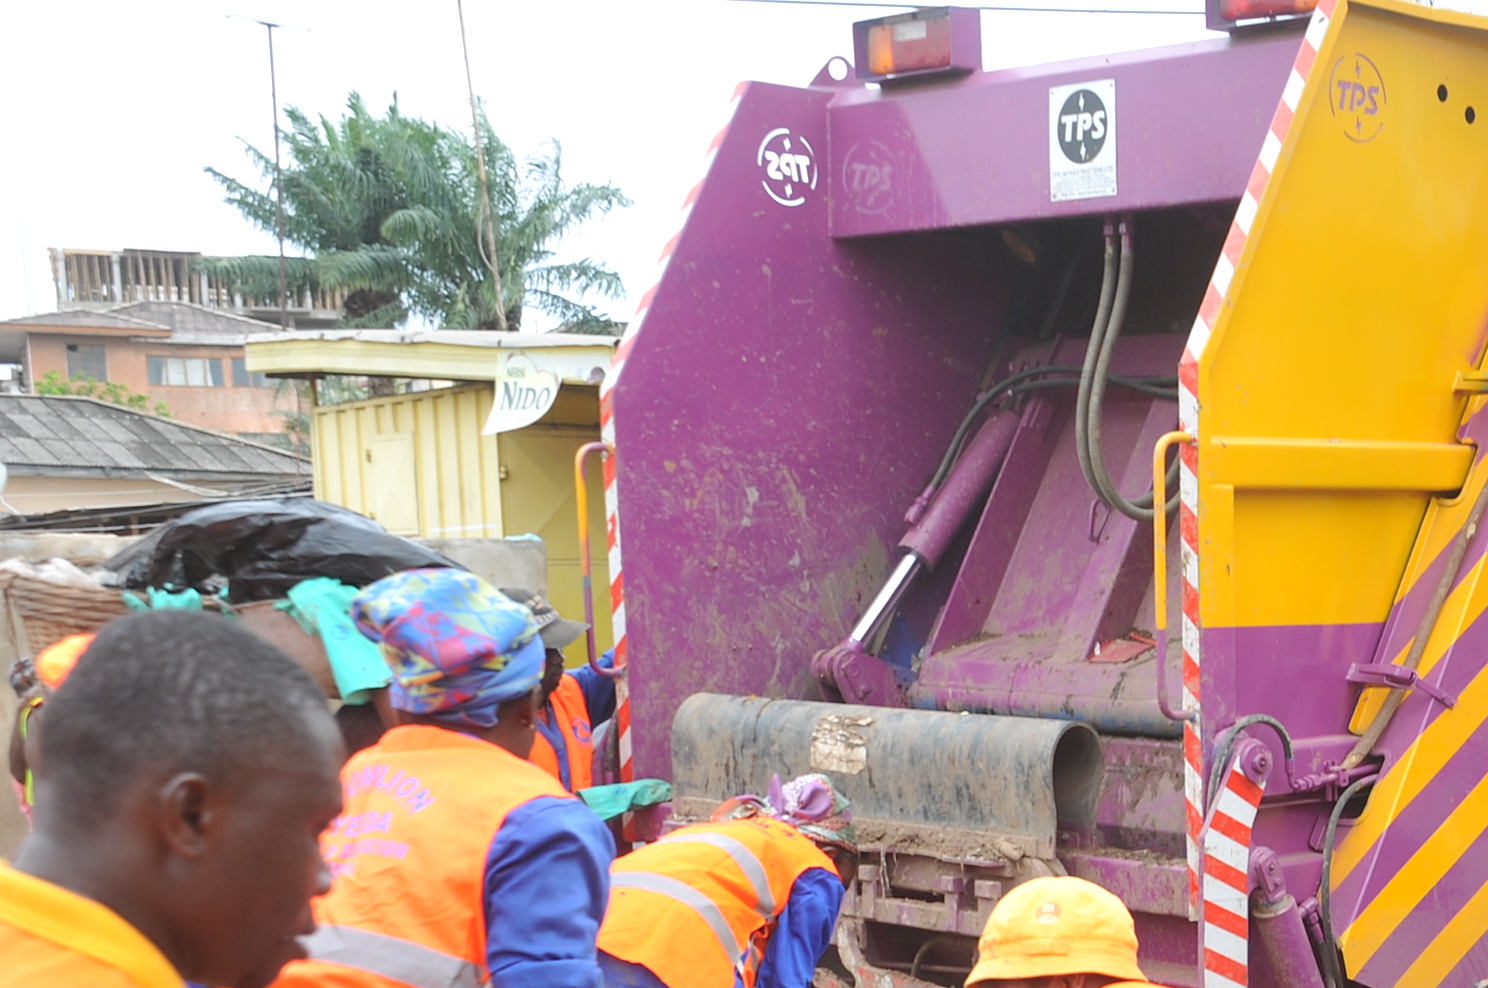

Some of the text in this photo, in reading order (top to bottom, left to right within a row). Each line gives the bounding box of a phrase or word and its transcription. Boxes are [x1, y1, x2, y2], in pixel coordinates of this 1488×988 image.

[1336, 80, 1380, 117] TPS
[1061, 110, 1105, 143] TPS
[851, 162, 893, 191] TPS
[500, 381, 551, 410] NIDO
